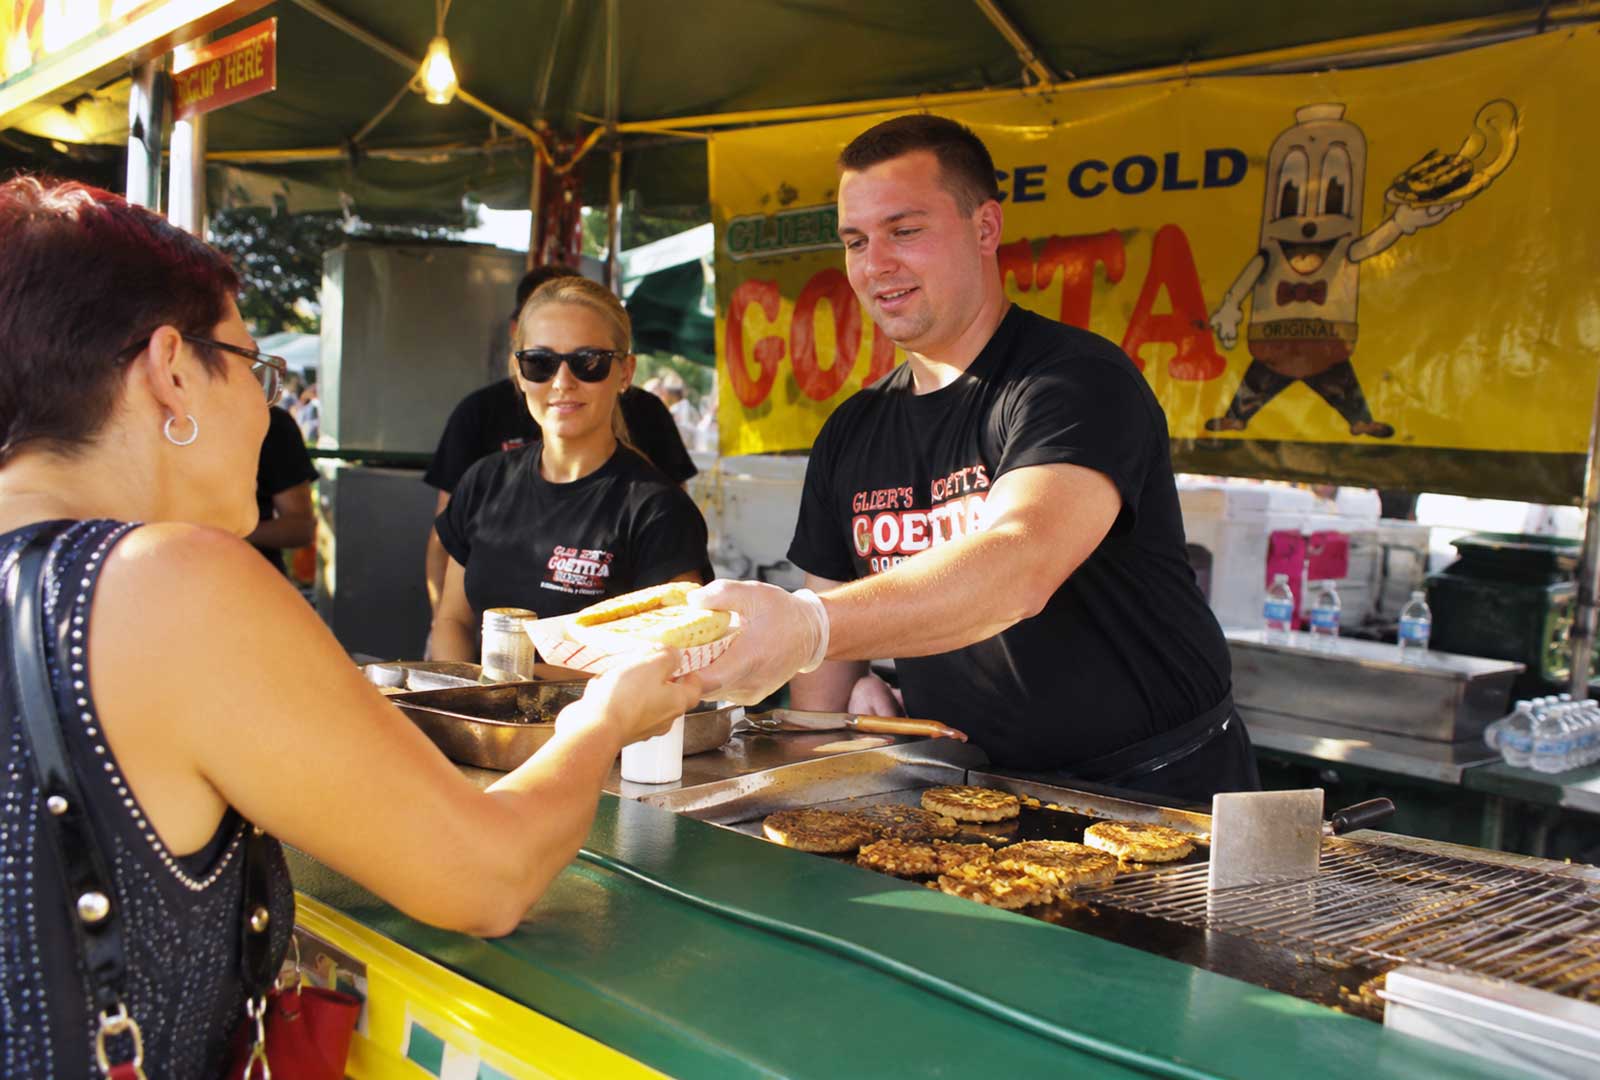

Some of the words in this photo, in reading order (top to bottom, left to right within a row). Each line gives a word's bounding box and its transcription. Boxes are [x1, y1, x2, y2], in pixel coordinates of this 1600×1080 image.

[224, 43, 265, 89] HERE
[1067, 148, 1249, 199] COLD
[727, 210, 839, 252] GLIER
[725, 223, 1227, 409] GOTA
[1263, 322, 1338, 339] ORIGINAL
